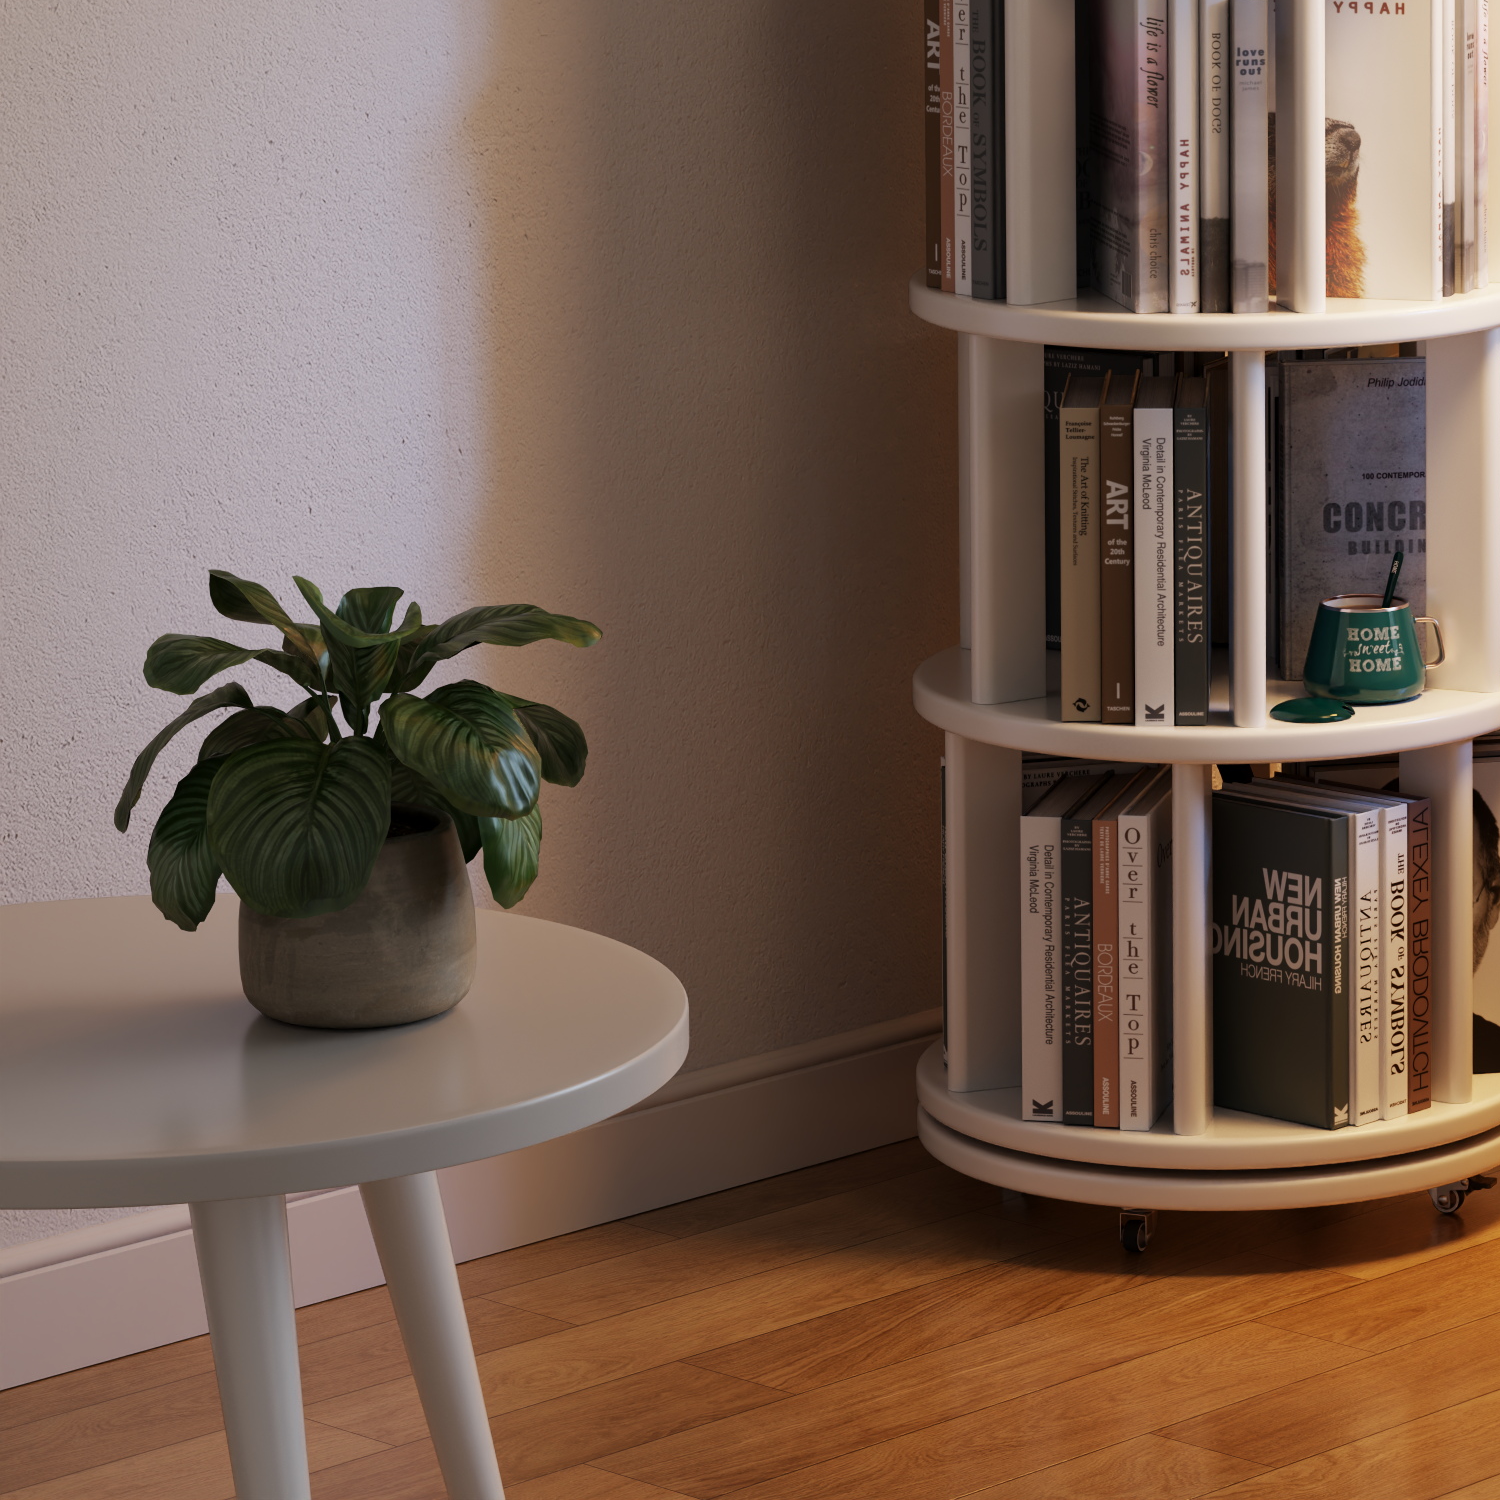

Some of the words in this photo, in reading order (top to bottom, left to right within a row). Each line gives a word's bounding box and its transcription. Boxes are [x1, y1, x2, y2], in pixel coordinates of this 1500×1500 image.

[1140, 16, 1164, 37] life
[1146, 42, 1162, 53] is
[1146, 56, 1158, 66] a
[1235, 58, 1266, 67] runs
[1236, 46, 1265, 57] love
[973, 39, 988, 108] BOOK
[1140, 66, 1164, 109] flower
[1239, 66, 1262, 76] out
[958, 67, 966, 124] the
[941, 91, 954, 178] BORDEAUX
[973, 111, 980, 128] OF
[958, 145, 968, 212] Top
[973, 133, 988, 252] SYMBOLS
[1149, 228, 1162, 249] chris
[1149, 250, 1162, 279] choice
[1367, 377, 1395, 390] Philip
[1080, 456, 1090, 473] The
[1140, 437, 1152, 472] Virginia
[1156, 437, 1166, 464] Detail
[1080, 474, 1090, 490] Art
[1156, 465, 1166, 474] in
[1361, 472, 1375, 480] 100
[1376, 470, 1426, 480] CONTEMPOR
[1080, 490, 1090, 500] of
[1105, 479, 1129, 530] ART
[1142, 473, 1152, 510] McLeod
[1154, 475, 1167, 540] Contemporary
[1079, 501, 1090, 537] Knitting
[1322, 500, 1426, 534] CONCR
[1107, 538, 1116, 546] of
[1116, 538, 1128, 546] the
[1109, 548, 1126, 556] 20th
[1346, 538, 1426, 556] BUILDIN
[1104, 557, 1131, 567] Century
[1156, 541, 1167, 592] Residential
[1184, 488, 1203, 643] ANTIQUAIRES
[1156, 593, 1167, 647] Architecture
[1346, 625, 1401, 642] HOME
[1348, 656, 1402, 673] HOME
[1356, 640, 1392, 658] sweet
[1023, 773, 1032, 781] BY
[1033, 771, 1055, 780] LAURE
[1027, 843, 1040, 878] Virginia
[1044, 843, 1054, 870] Detail
[1124, 827, 1141, 899] Over
[1044, 871, 1054, 880] in
[1029, 879, 1040, 914] McLeod
[1042, 880, 1055, 942] Contemporary
[1126, 922, 1139, 976] the
[1044, 943, 1055, 992] Residential
[1070, 897, 1092, 1046] ANTIQUAIRES
[1097, 943, 1113, 1022] BORDEAUX
[1044, 993, 1056, 1046] Architecture
[1126, 994, 1141, 1055] Top
[1102, 1077, 1110, 1115] ASSOULINE
[1130, 1080, 1138, 1118] ASSOULINE
